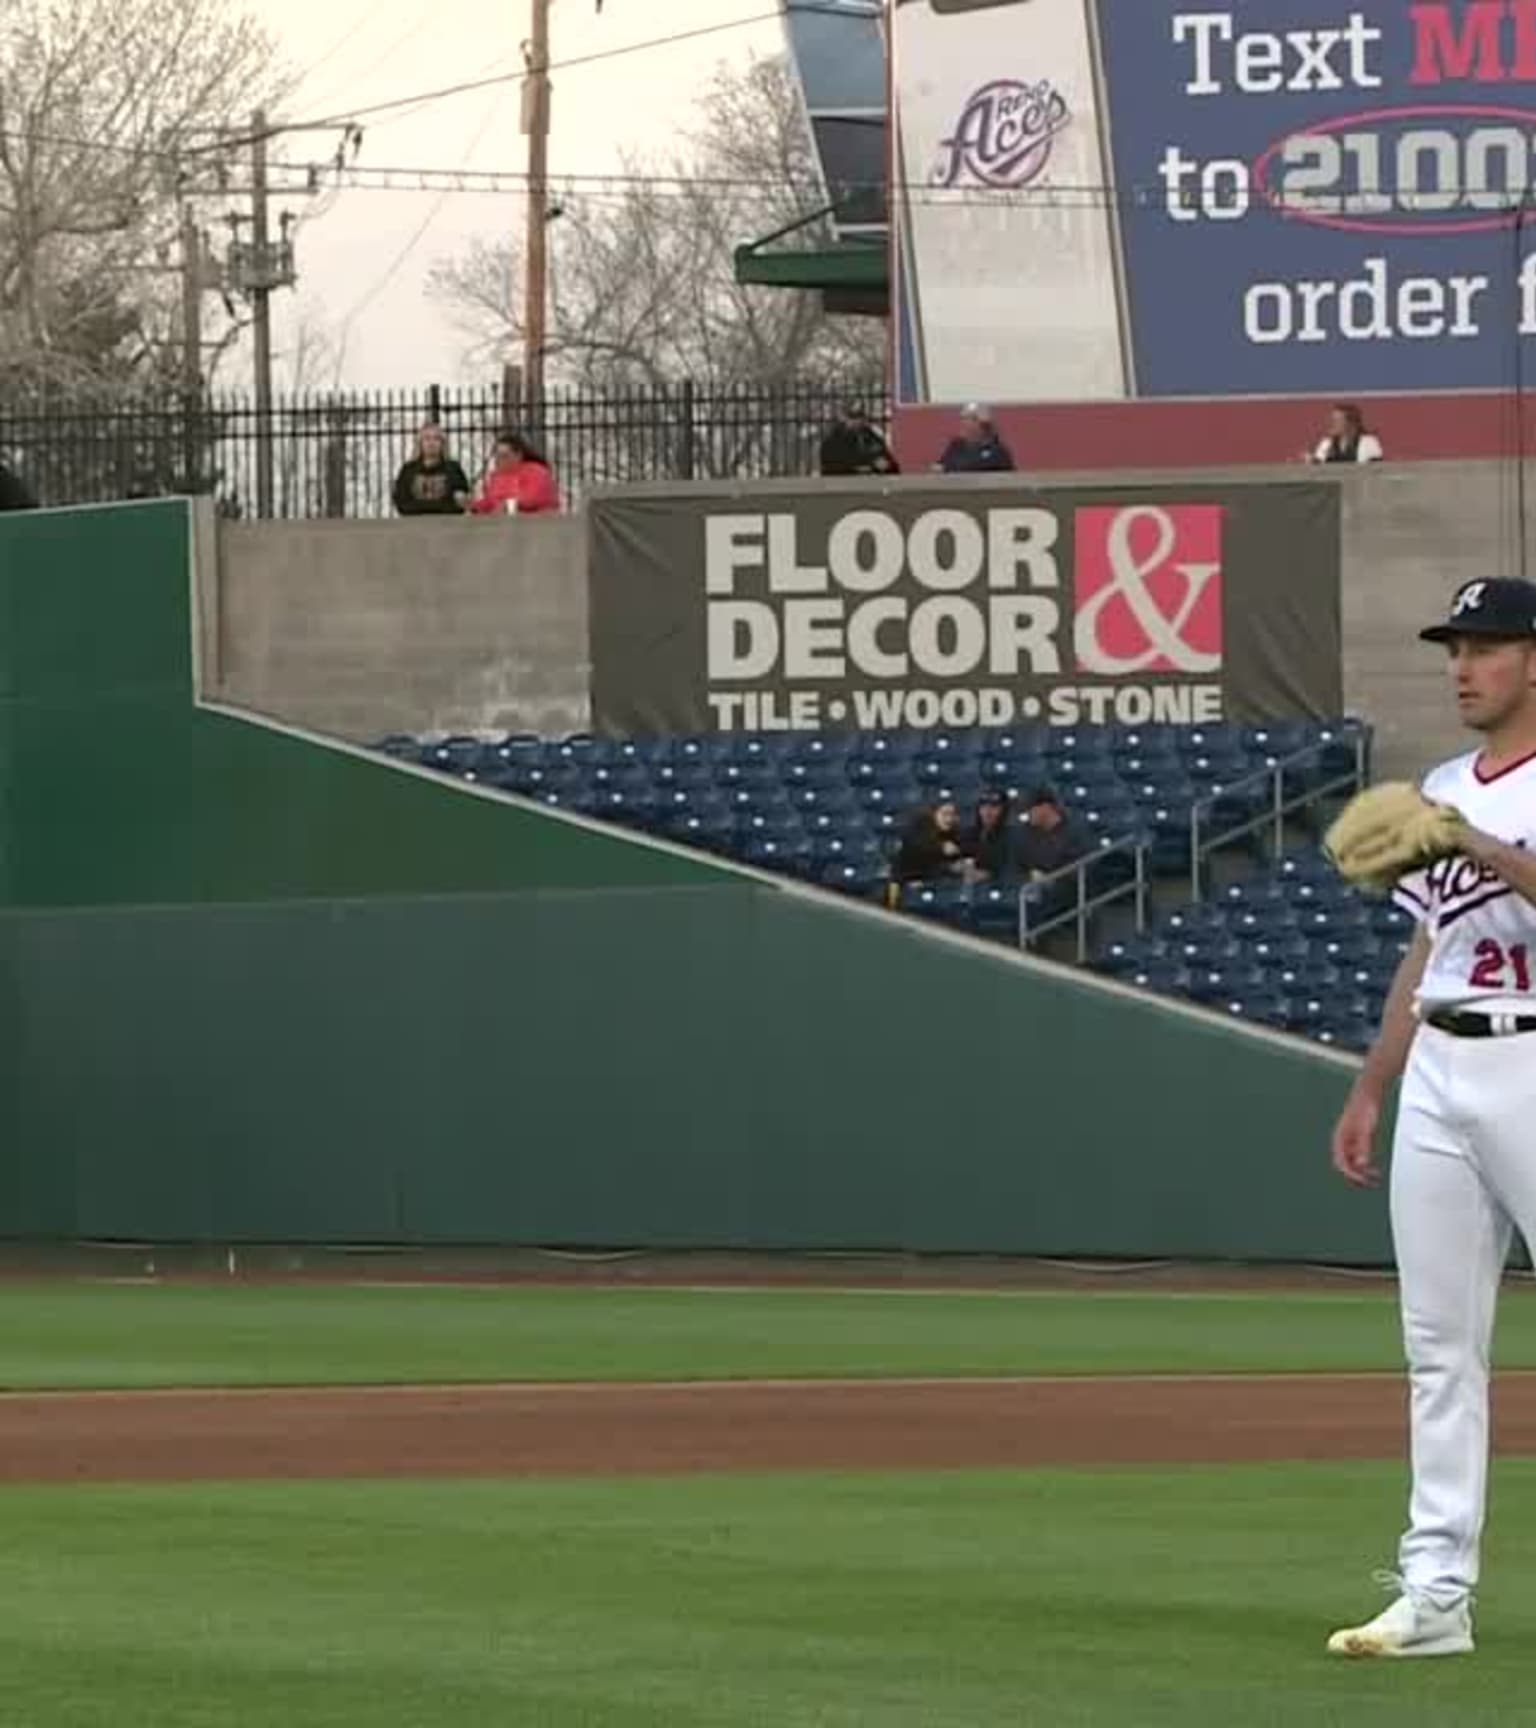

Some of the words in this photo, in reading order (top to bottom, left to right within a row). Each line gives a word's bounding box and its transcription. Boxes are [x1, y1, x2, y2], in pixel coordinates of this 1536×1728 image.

[1172, 13, 1382, 95] Text
[928, 89, 1072, 188] Aces
[1158, 147, 1250, 220] to
[1242, 258, 1490, 344] order
[705, 507, 1061, 594] FLOOR
[707, 595, 1062, 680] DECOR
[709, 690, 820, 731] TILE
[853, 688, 1014, 730] WOOD
[1047, 684, 1223, 726] STONE
[1468, 937, 1530, 991] 21
